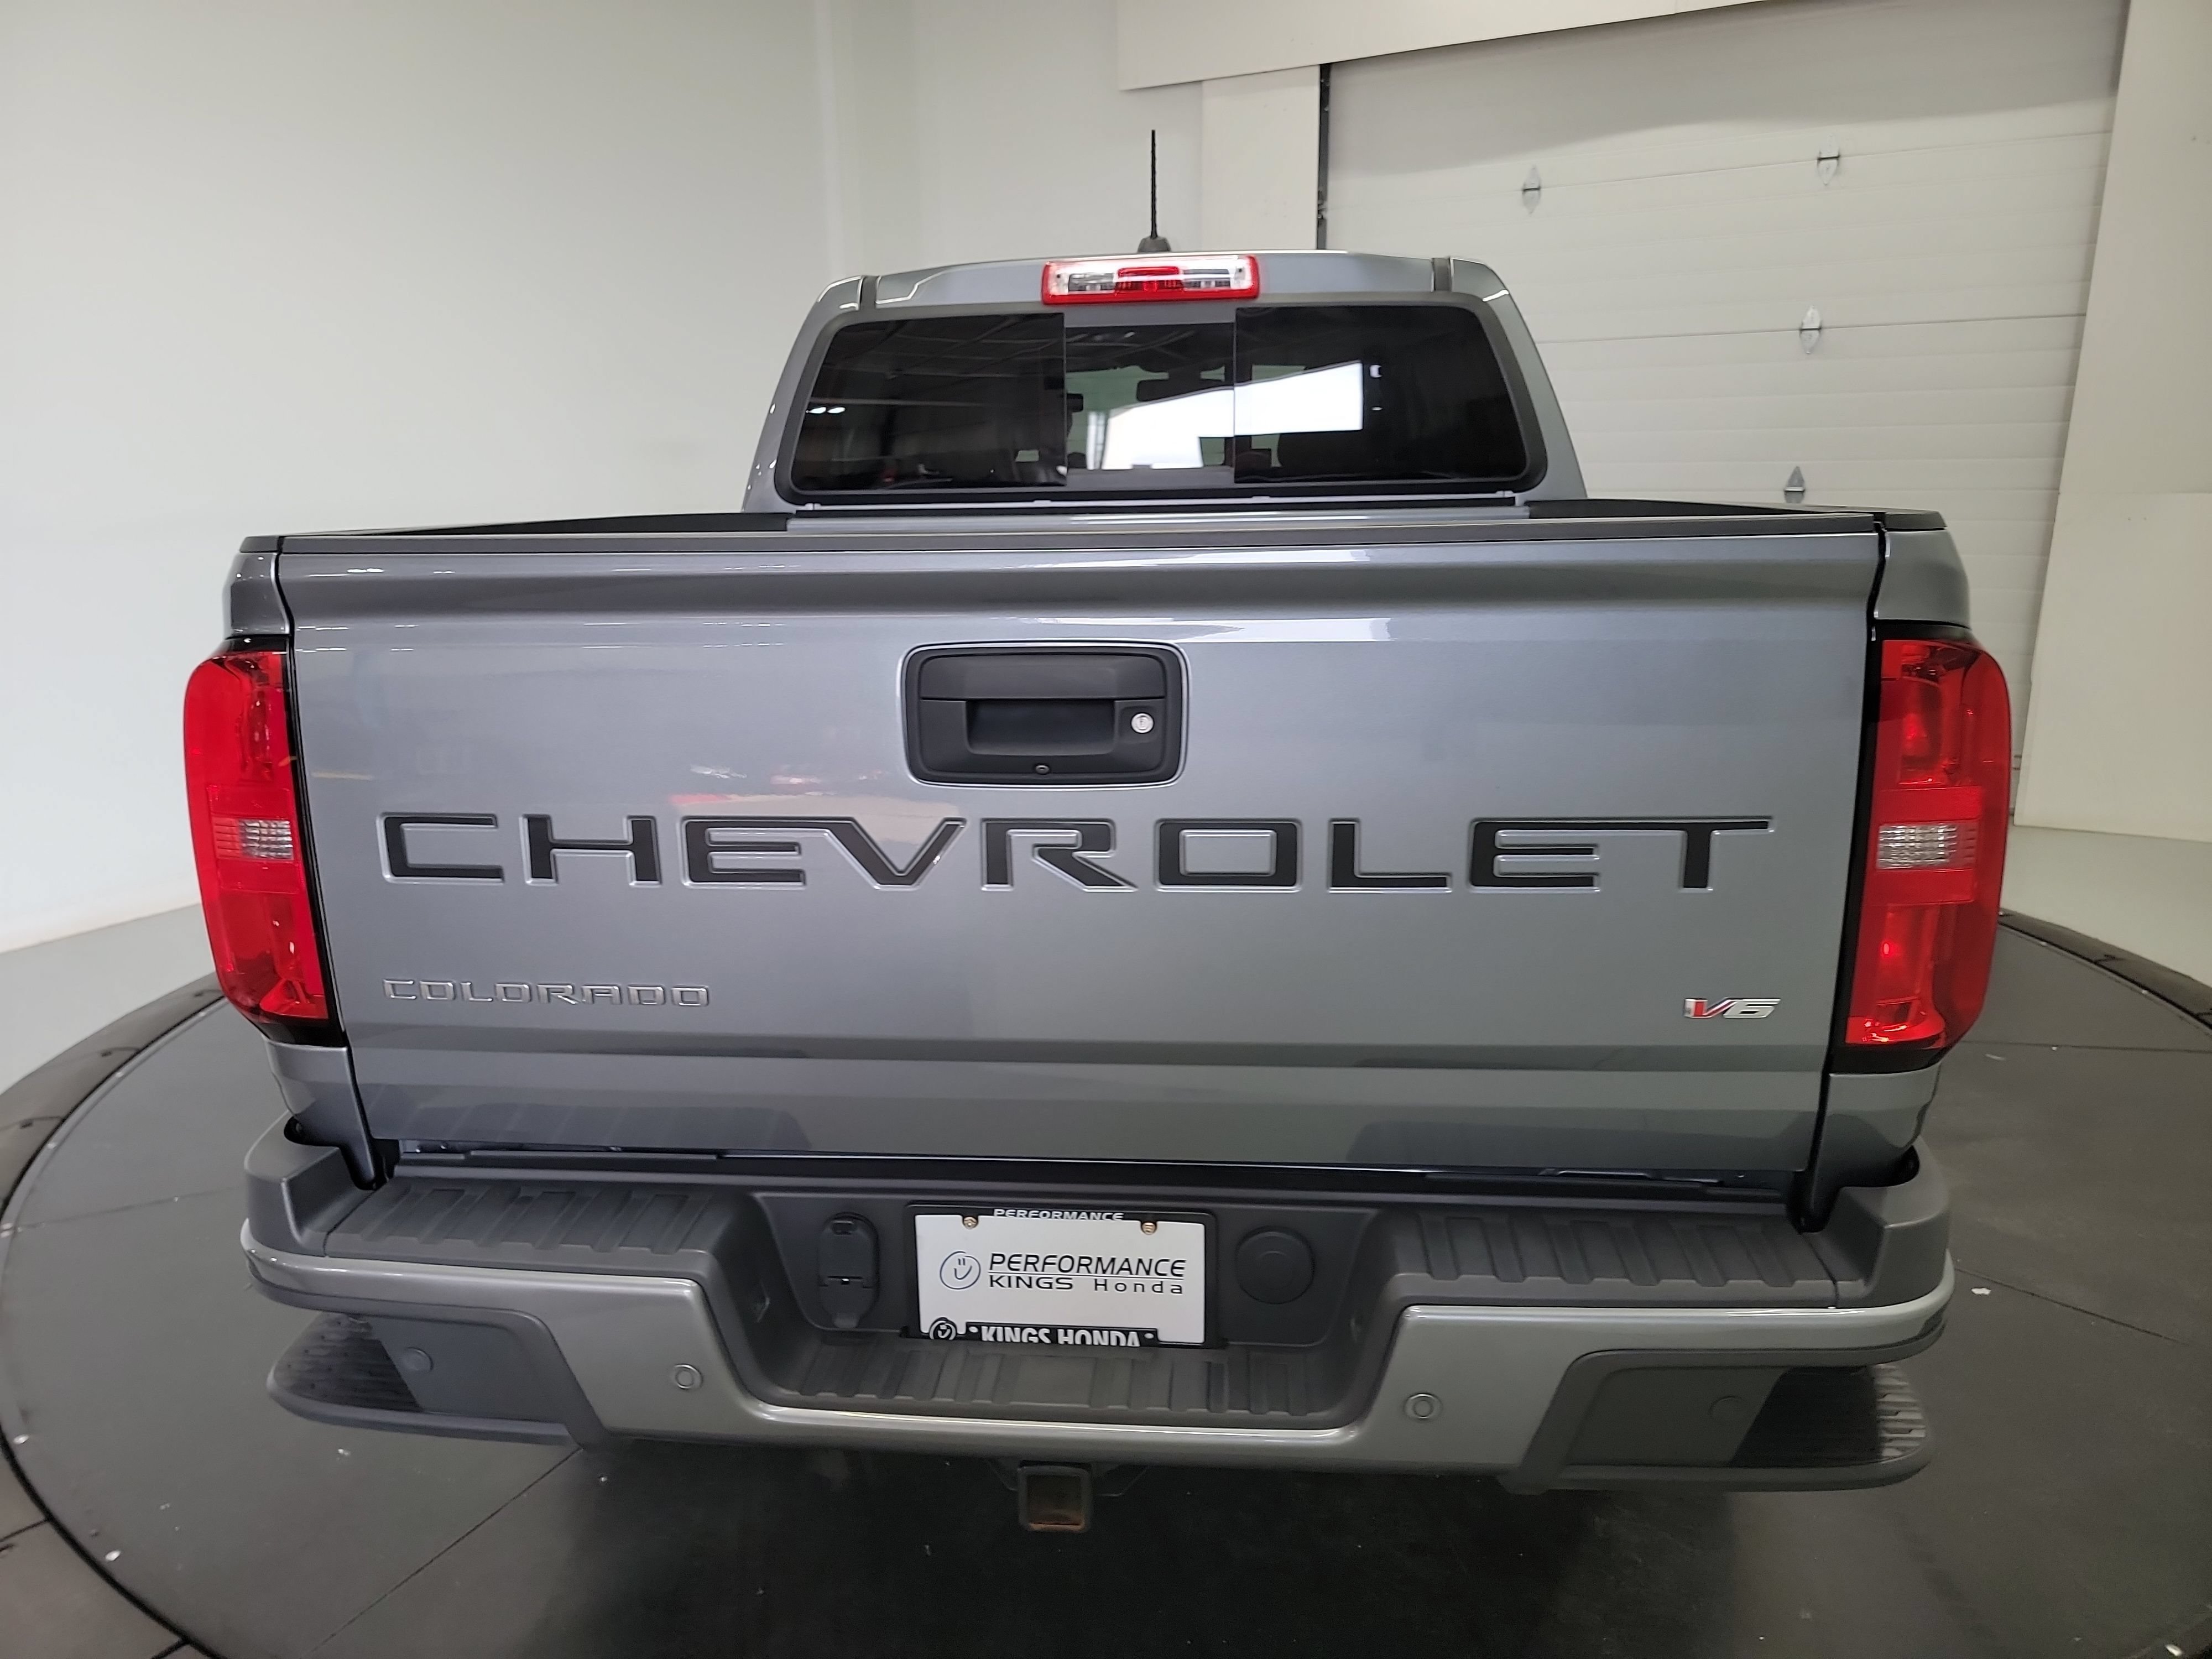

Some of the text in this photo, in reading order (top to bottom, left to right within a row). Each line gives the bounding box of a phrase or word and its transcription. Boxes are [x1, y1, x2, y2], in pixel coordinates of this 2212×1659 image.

[377, 812, 1775, 894] CHEVROLET
[383, 979, 709, 1006] COLORADO
[1683, 998, 1781, 1018] V6
[994, 1209, 1124, 1221] PERFORMANCE
[990, 1253, 1186, 1276] PERFORMANCE
[989, 1275, 1182, 1295] KINGS Honda
[981, 1326, 1141, 1347] KINGS HONDA
